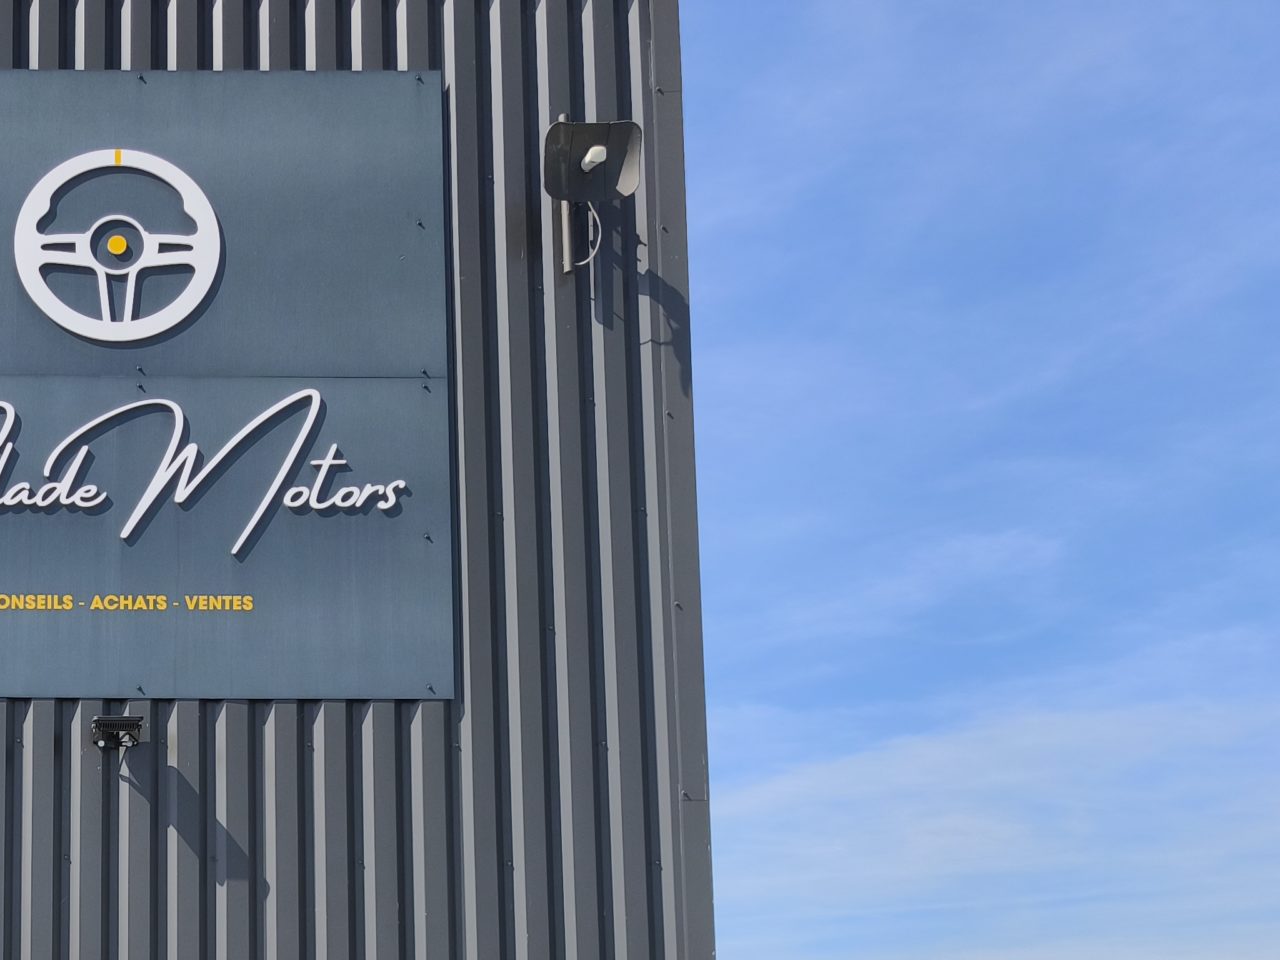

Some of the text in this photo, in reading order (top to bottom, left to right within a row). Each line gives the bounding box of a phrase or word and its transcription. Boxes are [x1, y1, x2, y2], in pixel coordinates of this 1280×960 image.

[43, 388, 407, 557] Motors
[89, 594, 168, 611] ACHATS
[184, 594, 255, 611] VENTES
